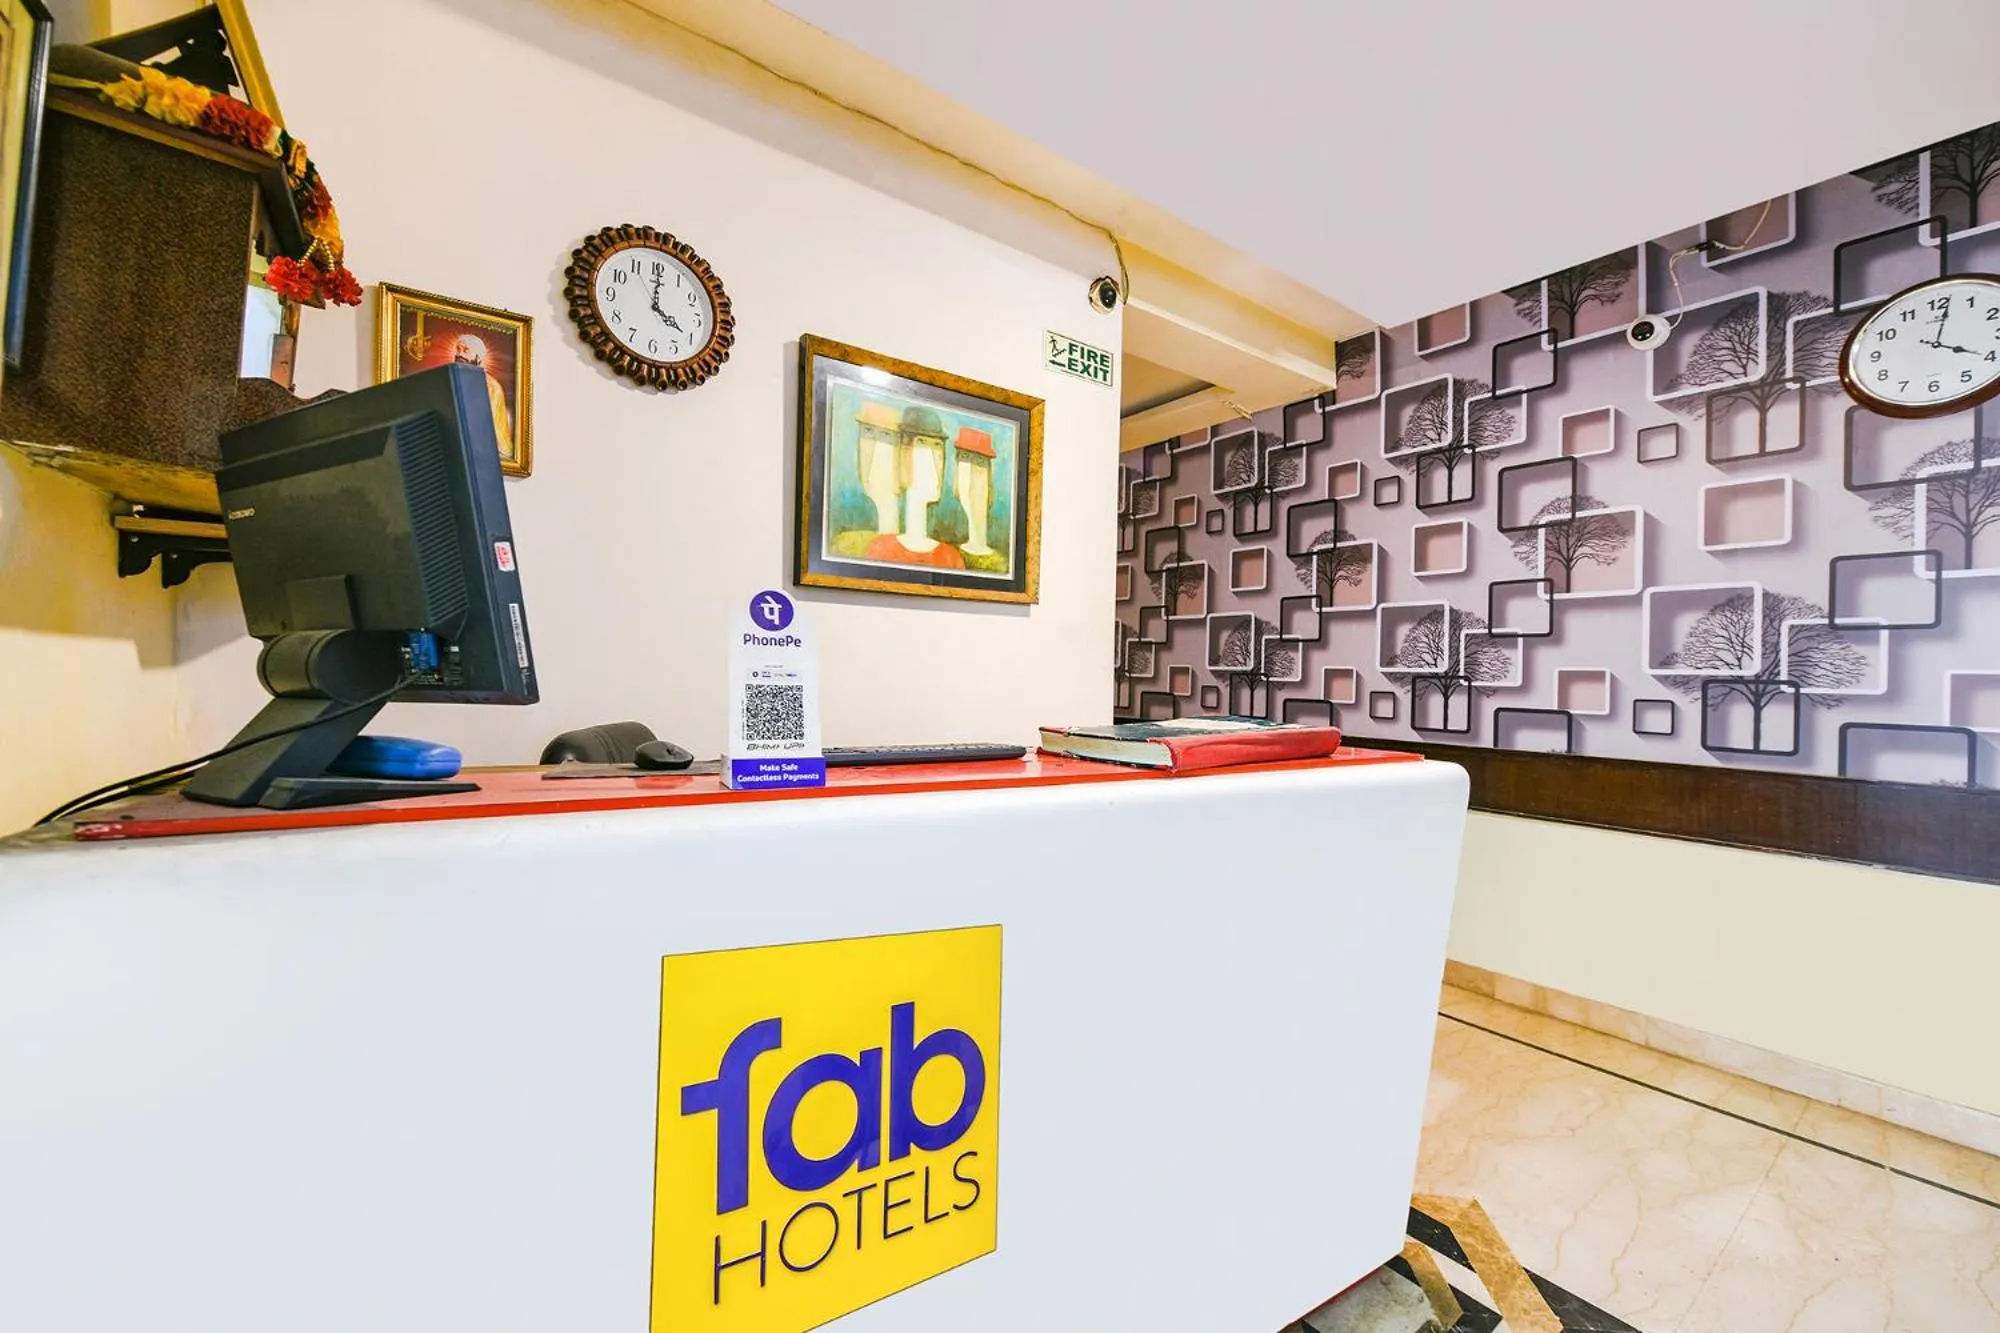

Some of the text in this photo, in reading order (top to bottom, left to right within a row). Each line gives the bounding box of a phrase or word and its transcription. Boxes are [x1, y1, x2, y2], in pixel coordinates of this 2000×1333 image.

[631, 259, 641, 275] 11
[613, 268, 627, 285] 10
[606, 286, 616, 302] 9
[688, 292, 697, 307] 2
[1927, 297, 1950, 311] 12
[1966, 296, 1974, 308] 1
[611, 309, 622, 325] 8
[1900, 309, 1916, 322] 11
[1986, 308, 1999, 320] 2
[628, 328, 638, 342] 7
[1877, 328, 1896, 342] 10
[648, 339, 658, 354] 6
[669, 340, 678, 354] 5
[1068, 342, 1110, 368] FIRE
[1870, 351, 1881, 363] 9
[1984, 350, 1997, 362] 4
[1068, 357, 1109, 381] EXIT
[1877, 369, 1889, 381] 8
[1960, 370, 1972, 383] 5
[1898, 381, 1910, 392] 7
[1928, 380, 1940, 392] 6
[743, 633, 802, 648] PhonePe
[783, 773, 819, 782] Payments
[680, 1001, 986, 1215] fab
[713, 1151, 980, 1305] HOTELS
